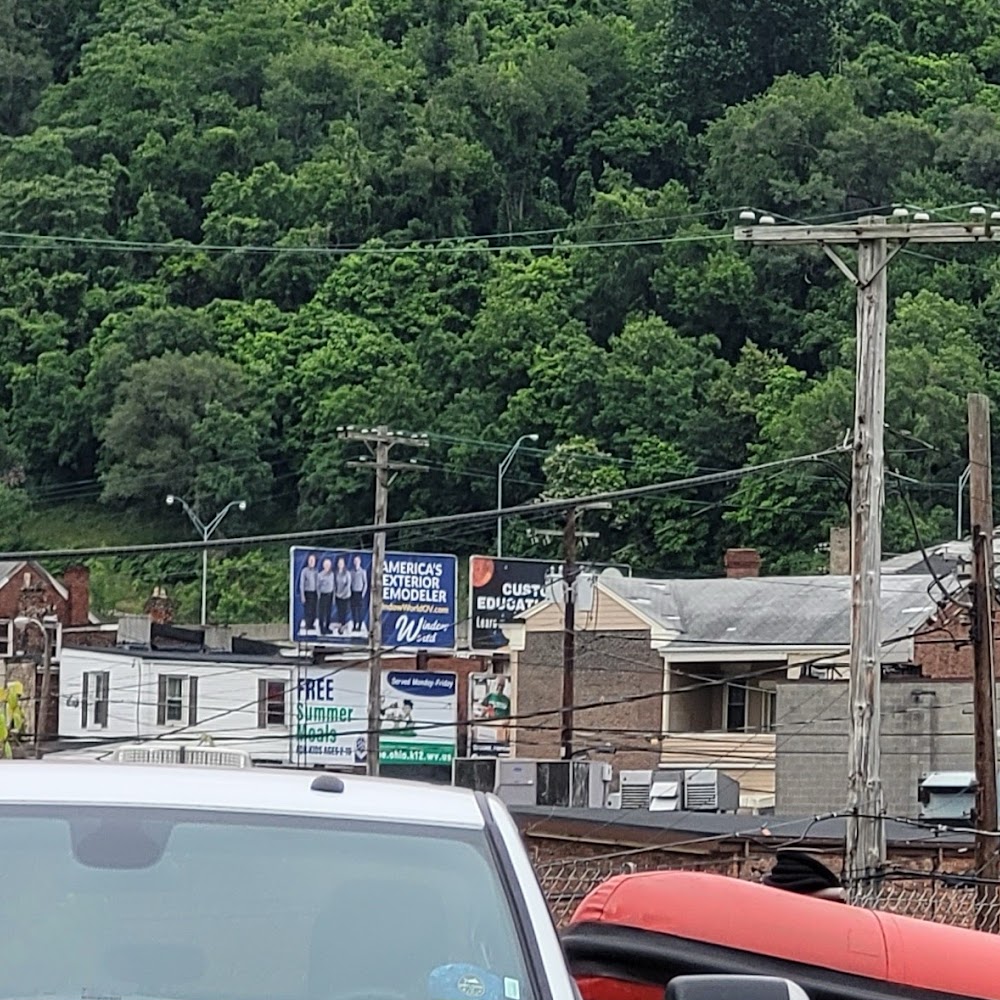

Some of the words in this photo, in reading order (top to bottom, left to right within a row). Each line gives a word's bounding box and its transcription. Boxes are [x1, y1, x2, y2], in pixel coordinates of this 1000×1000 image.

[382, 561, 443, 577] AMERICA'S
[382, 574, 440, 590] EXTERIOR
[502, 582, 547, 597] CUSTO
[382, 587, 447, 603] EMODELER
[297, 679, 334, 701] FREE
[296, 702, 353, 722] Summer
[297, 724, 337, 743] Meals
